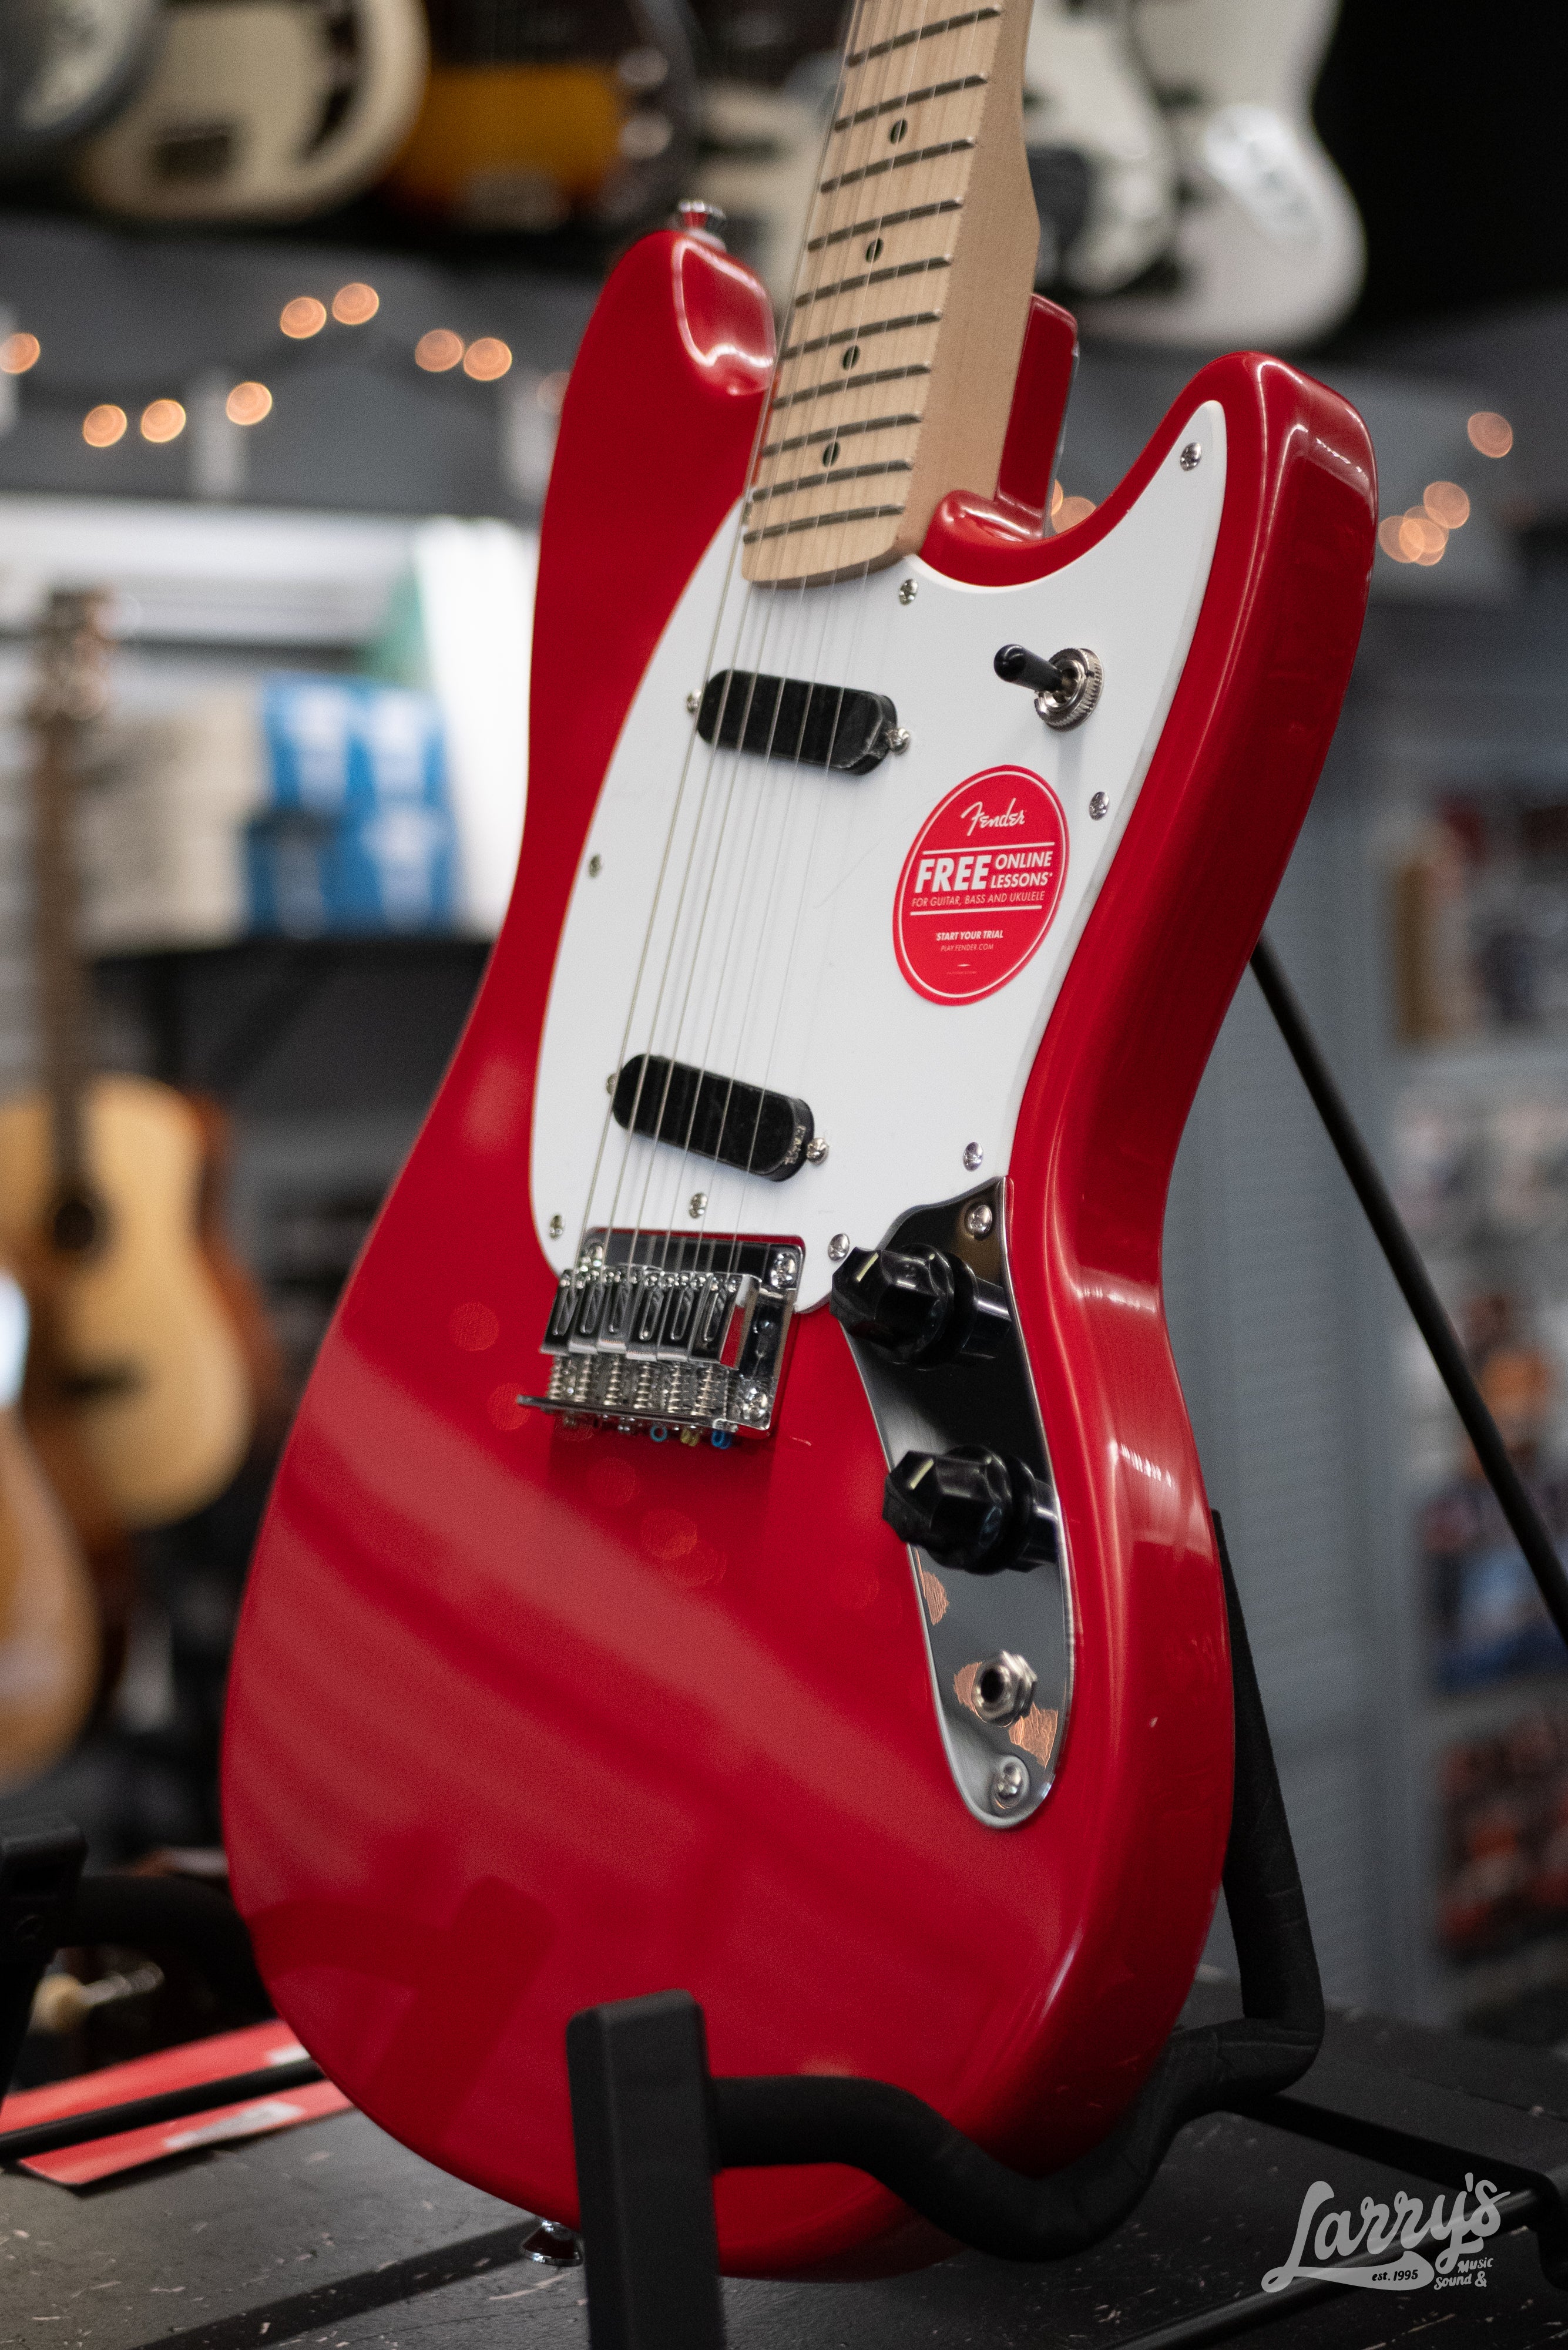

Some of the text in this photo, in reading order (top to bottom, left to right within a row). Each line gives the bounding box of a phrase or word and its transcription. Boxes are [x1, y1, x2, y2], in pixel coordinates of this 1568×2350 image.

[961, 798, 1026, 836] Fender
[915, 851, 1053, 894] FREE ONLINE
[912, 891, 1045, 907] FOR GUITAR, BASS AND UKULELE
[960, 931, 982, 940] YOUR
[983, 930, 1003, 939] TRIAL
